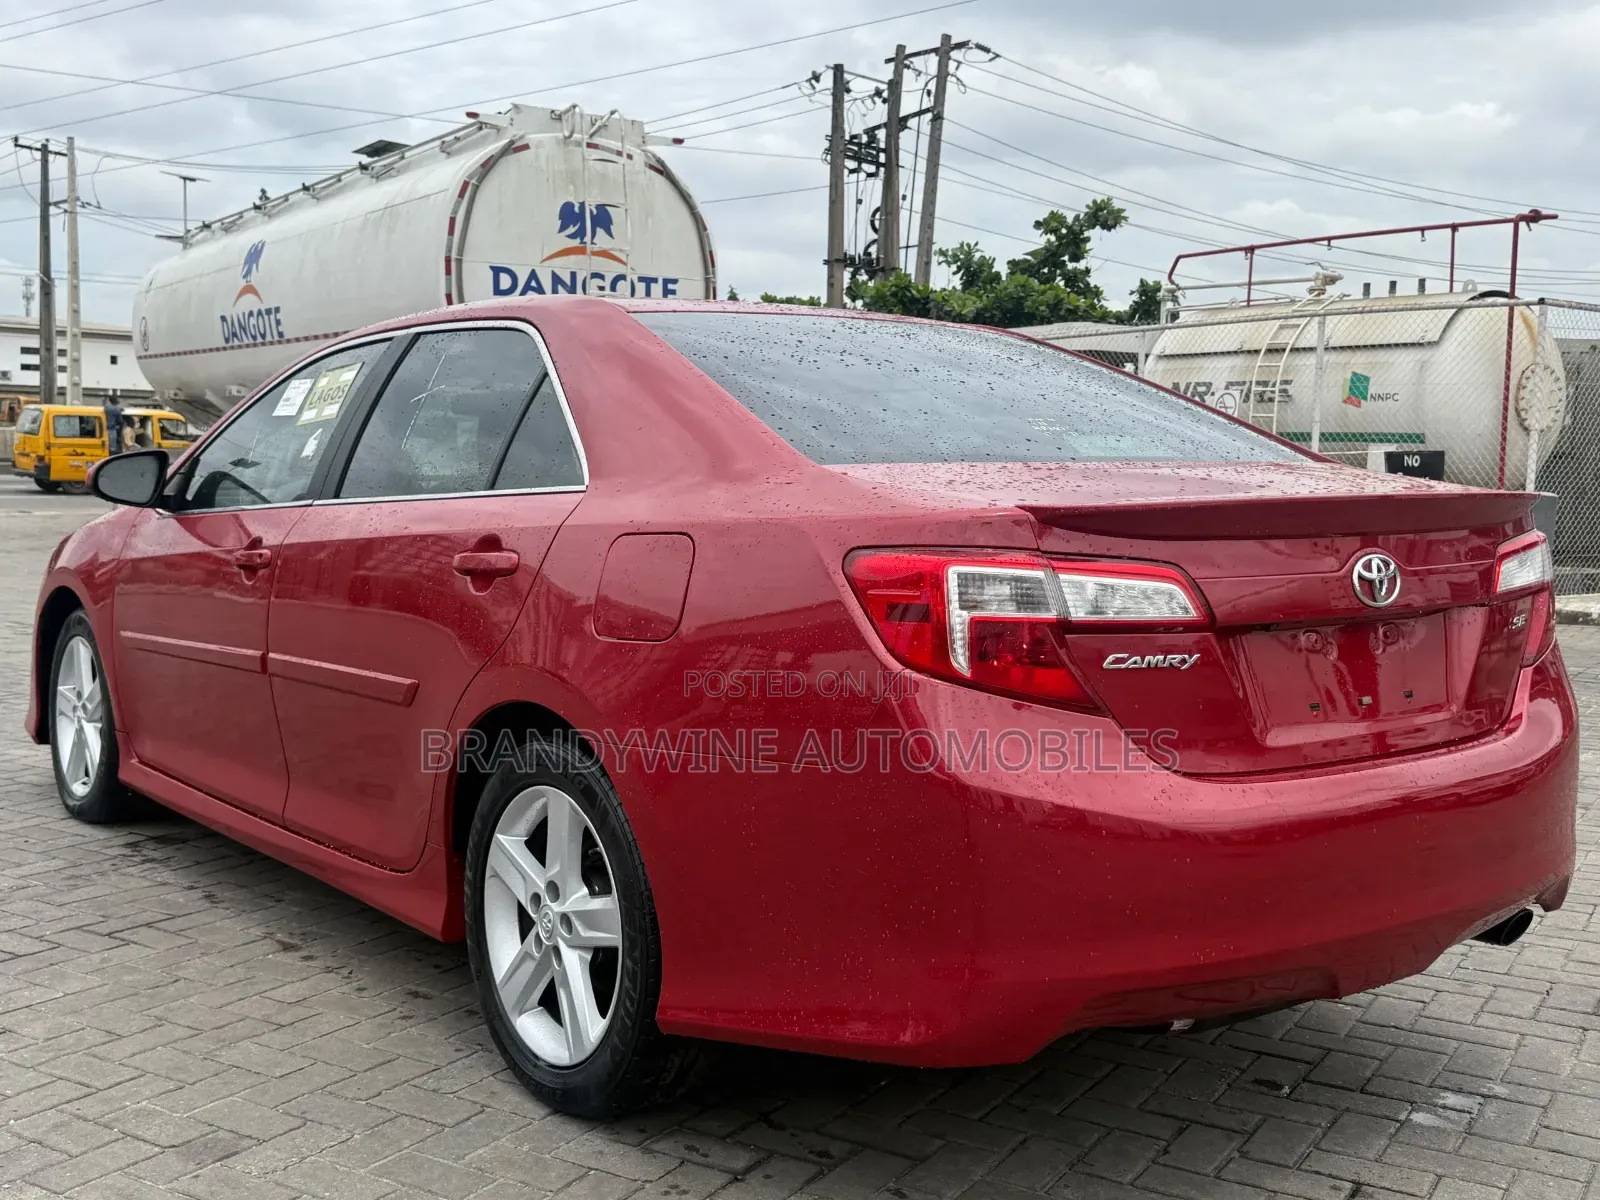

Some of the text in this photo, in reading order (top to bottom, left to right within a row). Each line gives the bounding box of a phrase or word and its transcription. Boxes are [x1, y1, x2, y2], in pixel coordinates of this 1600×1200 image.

[489, 265, 679, 299] DANGOTE
[220, 306, 284, 345] DANGOTE
[308, 384, 348, 406] LAGOS
[1369, 392, 1400, 403] NNPC
[1403, 454, 1421, 467] NO
[1102, 653, 1201, 670] CAMRY
